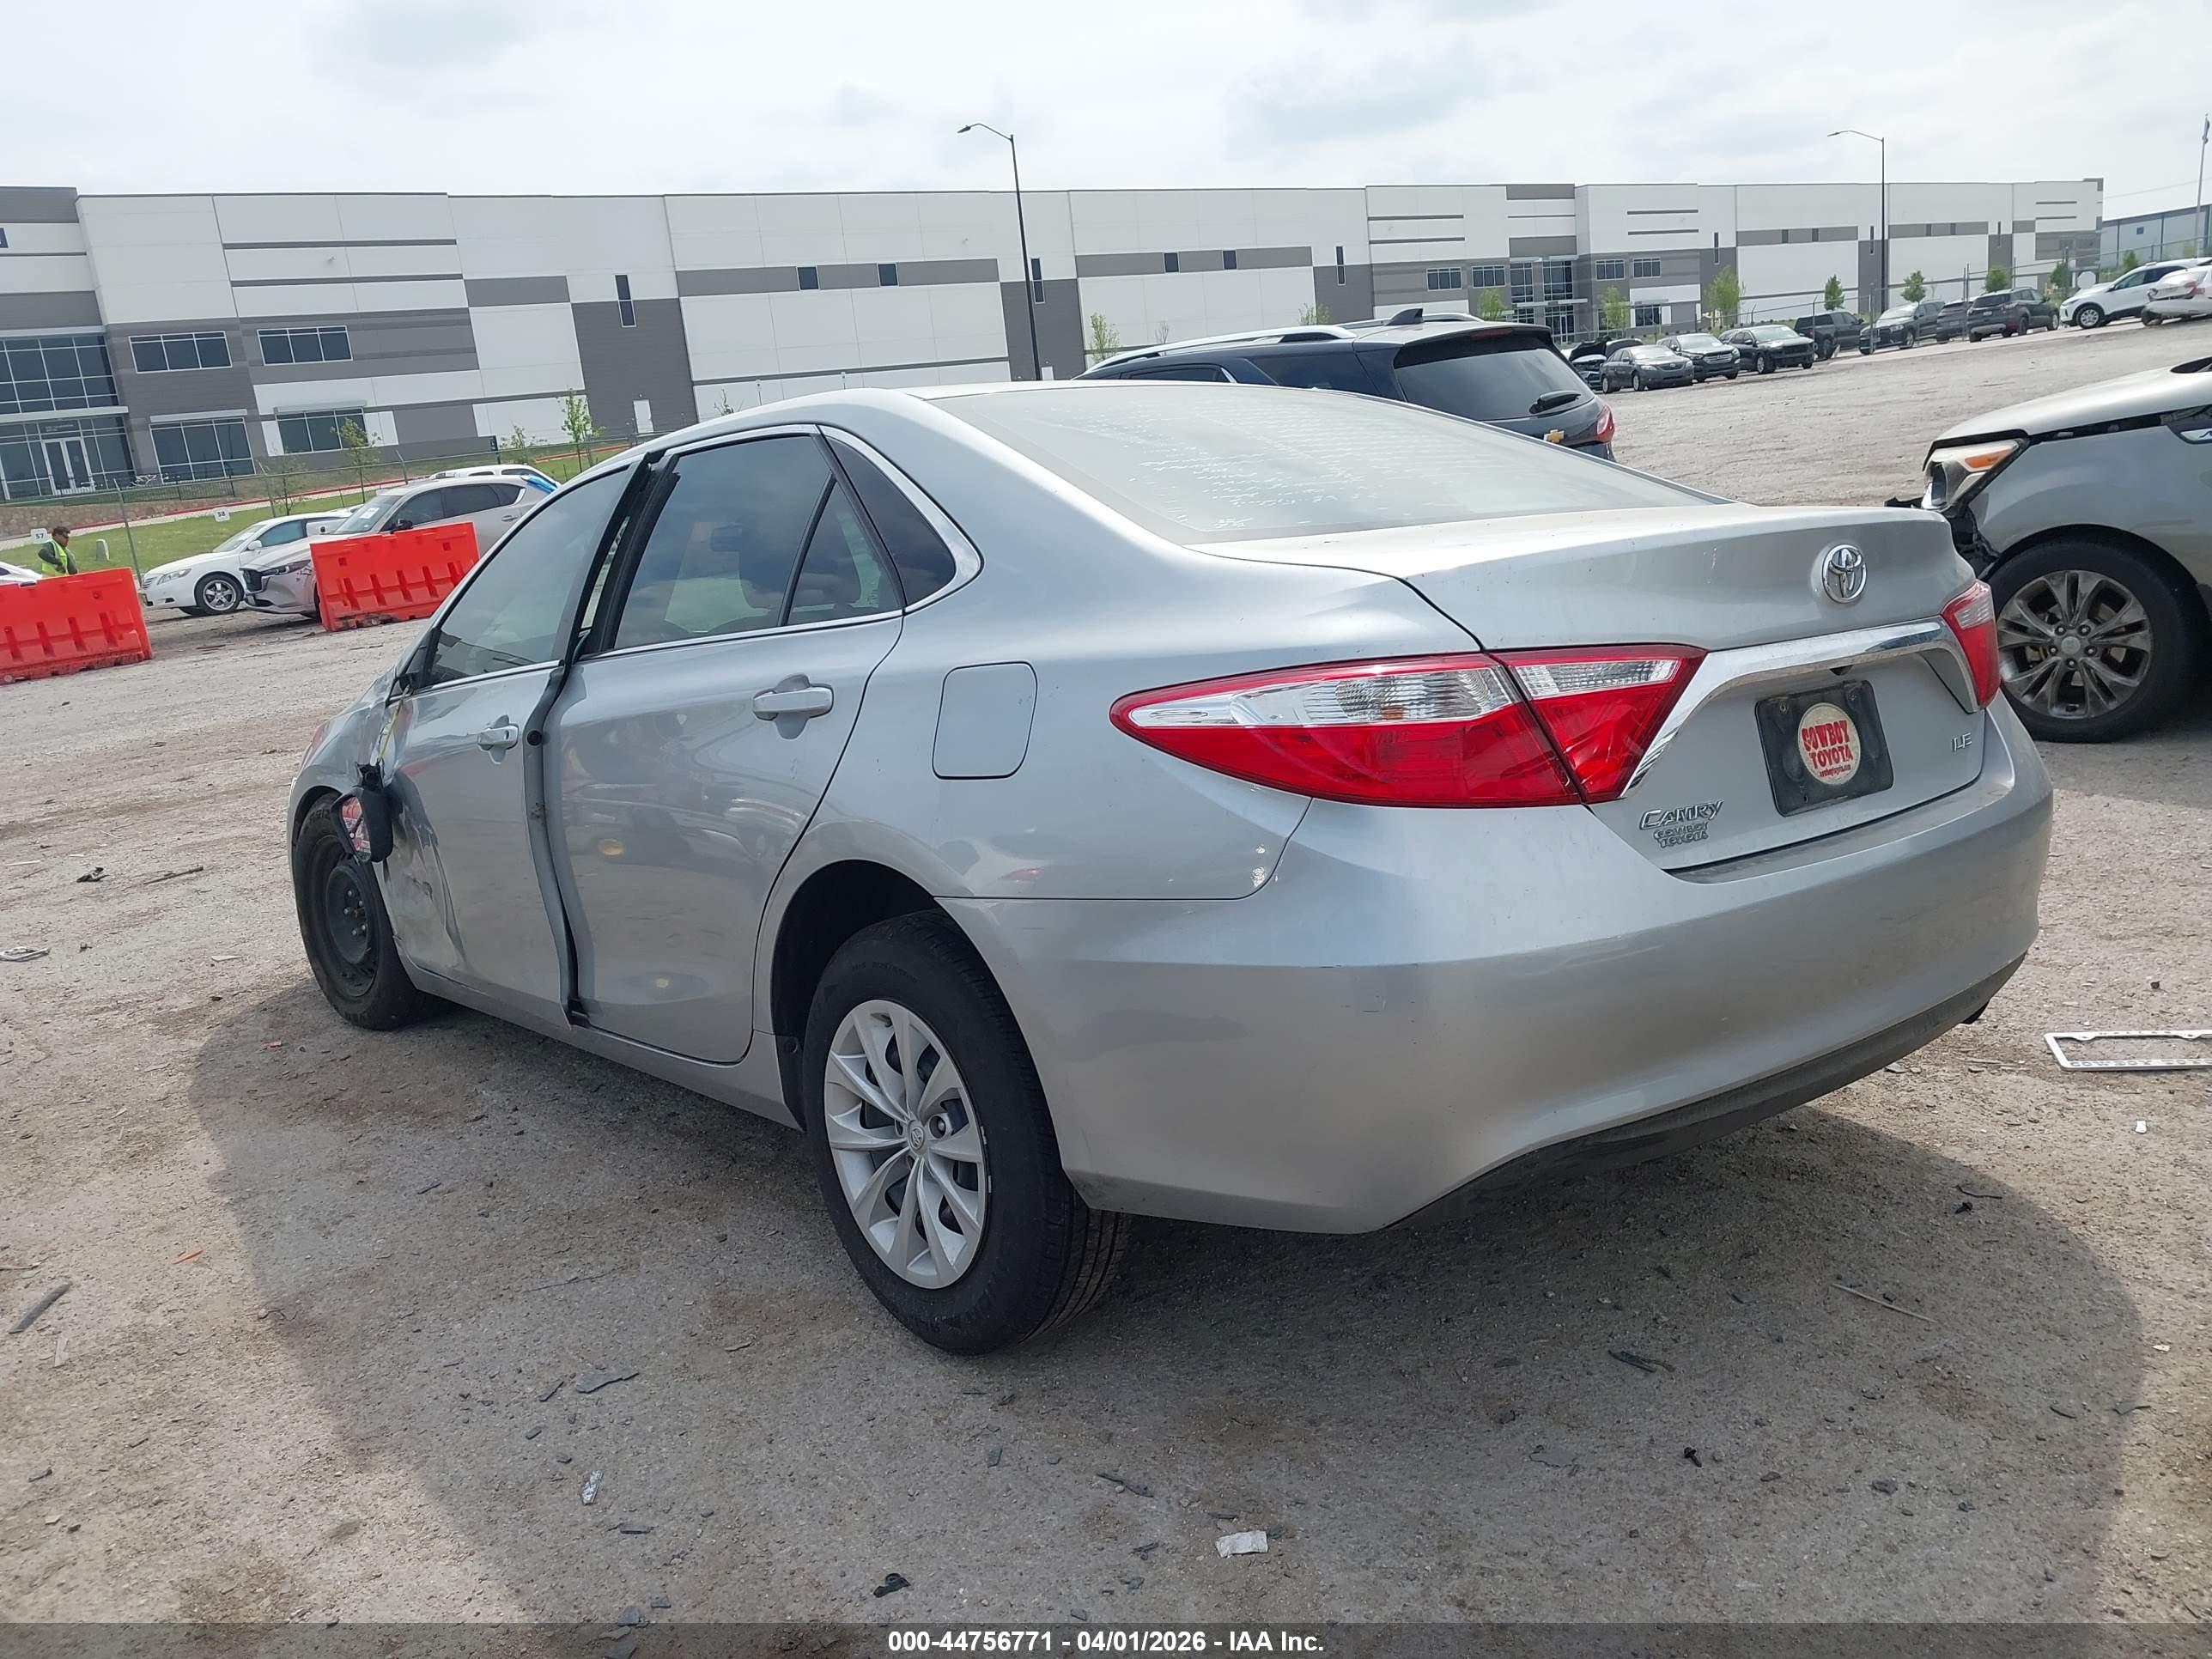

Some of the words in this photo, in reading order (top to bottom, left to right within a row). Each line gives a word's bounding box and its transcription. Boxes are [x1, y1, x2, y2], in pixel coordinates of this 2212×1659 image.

[1801, 720, 1850, 752] COWBOY
[1951, 732, 1972, 752] LE
[1809, 744, 1854, 769] TOYOTA
[1638, 799, 1724, 830] CAMRY
[1657, 830, 1709, 848] TOYOTA
